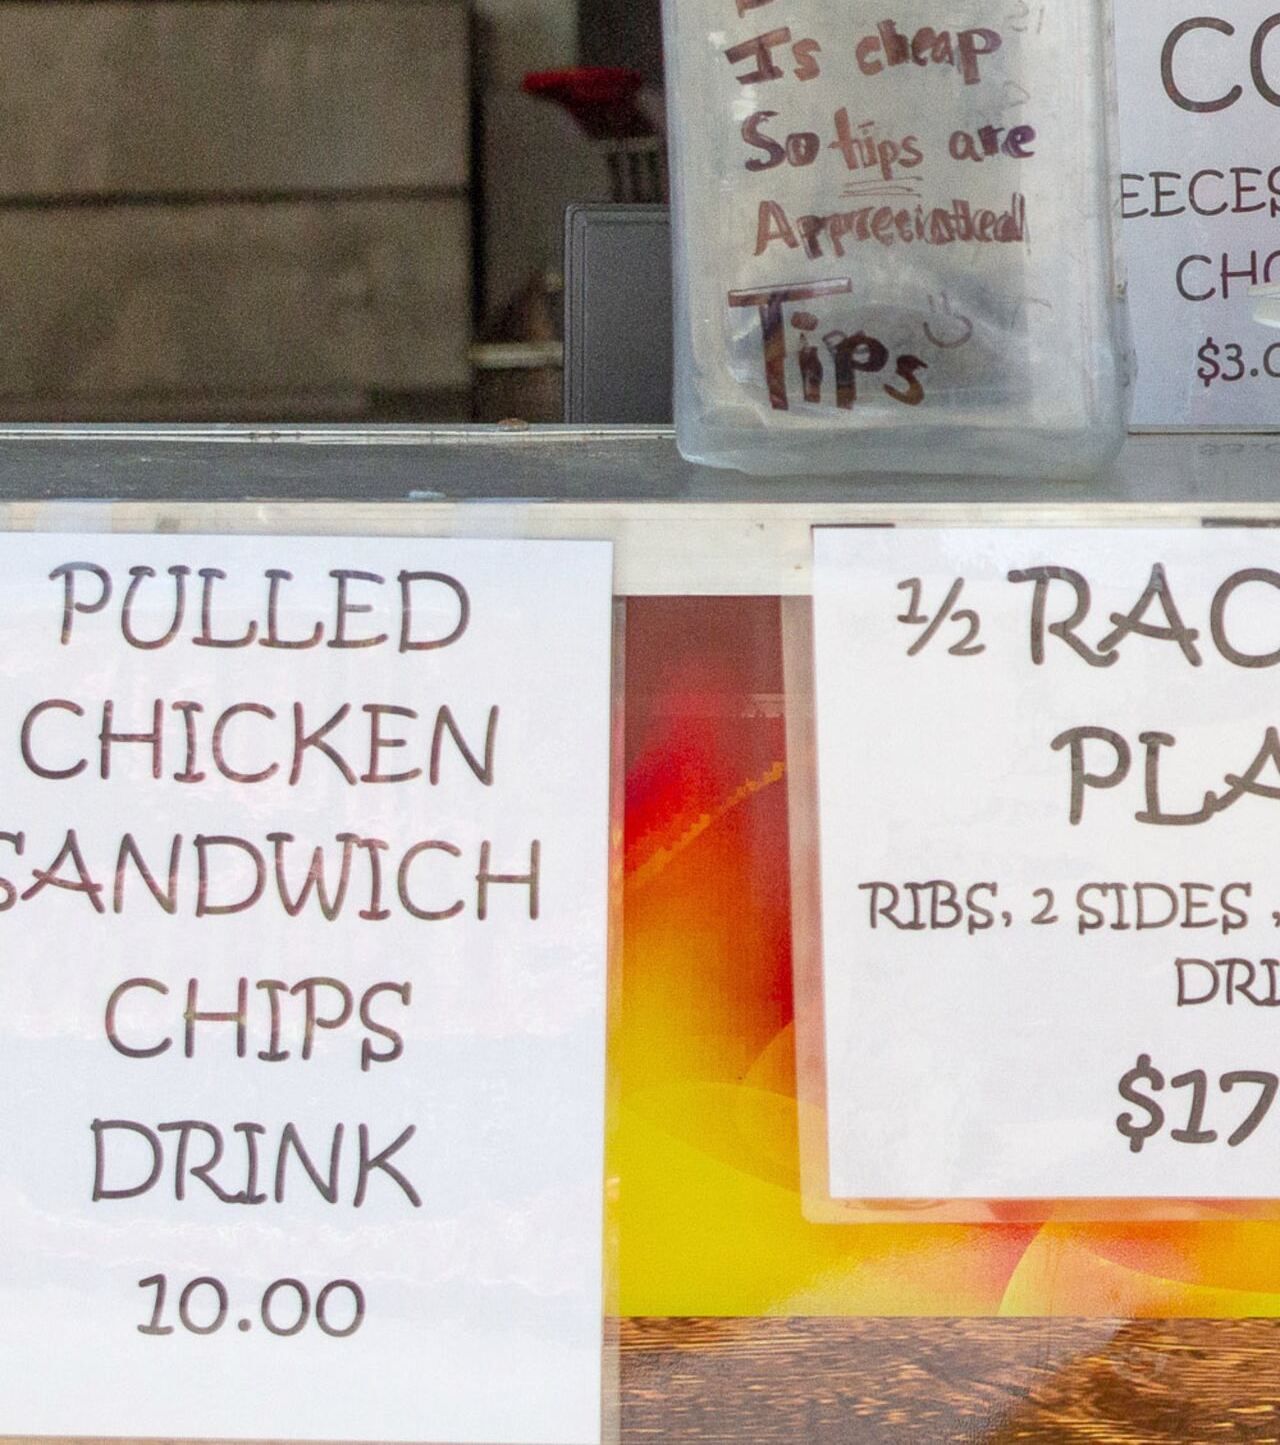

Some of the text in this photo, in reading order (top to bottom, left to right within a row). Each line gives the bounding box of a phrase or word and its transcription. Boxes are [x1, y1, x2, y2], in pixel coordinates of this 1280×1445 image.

[722, 20, 1001, 86] Is cheap
[741, 107, 1036, 174] So tips are
[727, 275, 928, 412] Tips
[47, 560, 472, 655] PULLED
[19, 697, 500, 788] CHICKEN
[856, 878, 1013, 937] RIBS,
[1029, 886, 1060, 926] 2
[1075, 880, 1253, 937] SIDES
[103, 975, 413, 1073] CHIPS
[88, 1116, 423, 1210] DRINK
[136, 1272, 367, 1339] 10.00
